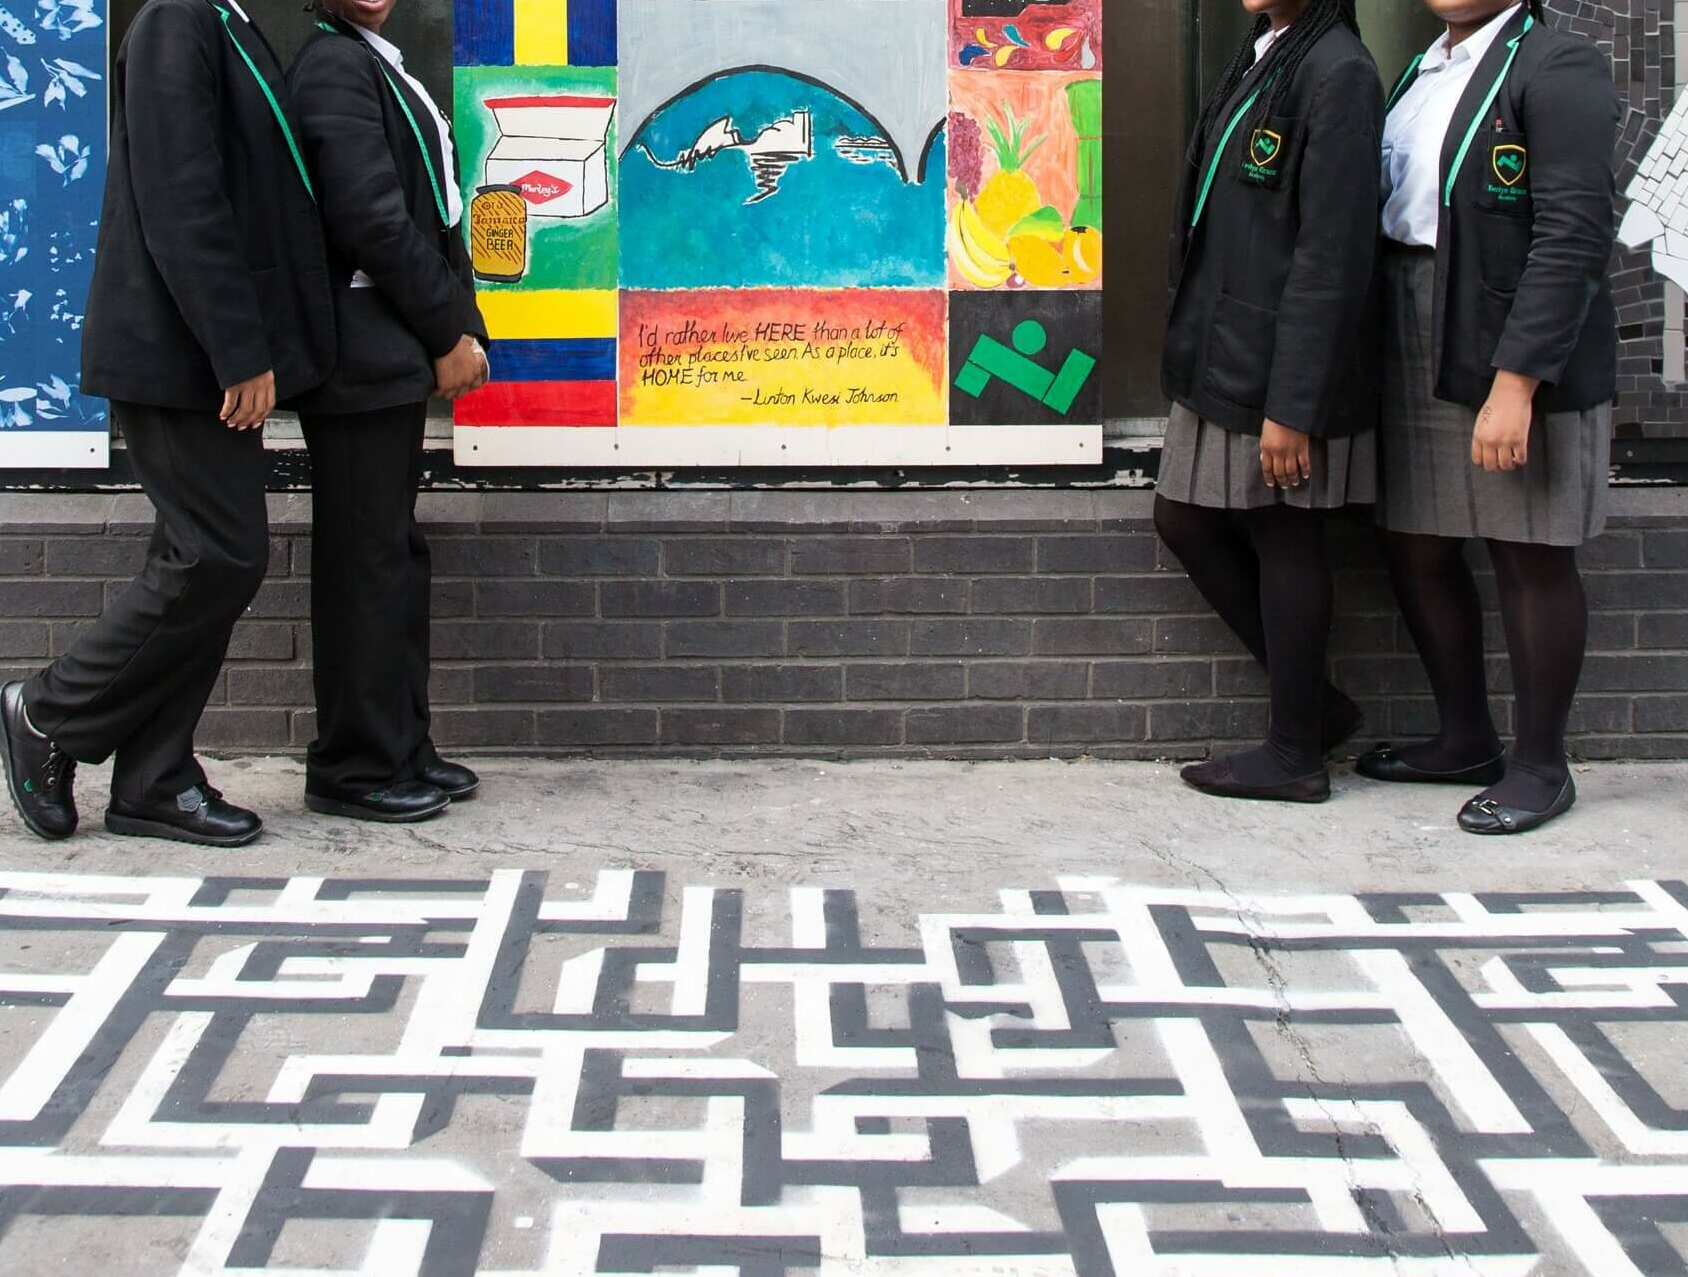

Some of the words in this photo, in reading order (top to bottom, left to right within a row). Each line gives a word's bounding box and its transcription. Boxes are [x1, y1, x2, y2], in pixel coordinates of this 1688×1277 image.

[486, 227, 514, 238] GINGER
[486, 238, 514, 251] BEER
[639, 323, 658, 348] I'd
[665, 320, 717, 345] rather
[754, 321, 806, 342] HERE
[813, 320, 848, 341] than
[850, 327, 861, 340] a
[864, 319, 887, 340] lot
[887, 322, 907, 344] of
[639, 346, 683, 368] other
[801, 342, 820, 359] As
[825, 346, 836, 359] a
[879, 342, 900, 358] it's
[642, 368, 694, 386] HOME
[696, 366, 719, 388] for
[802, 387, 841, 404] Kwesi
